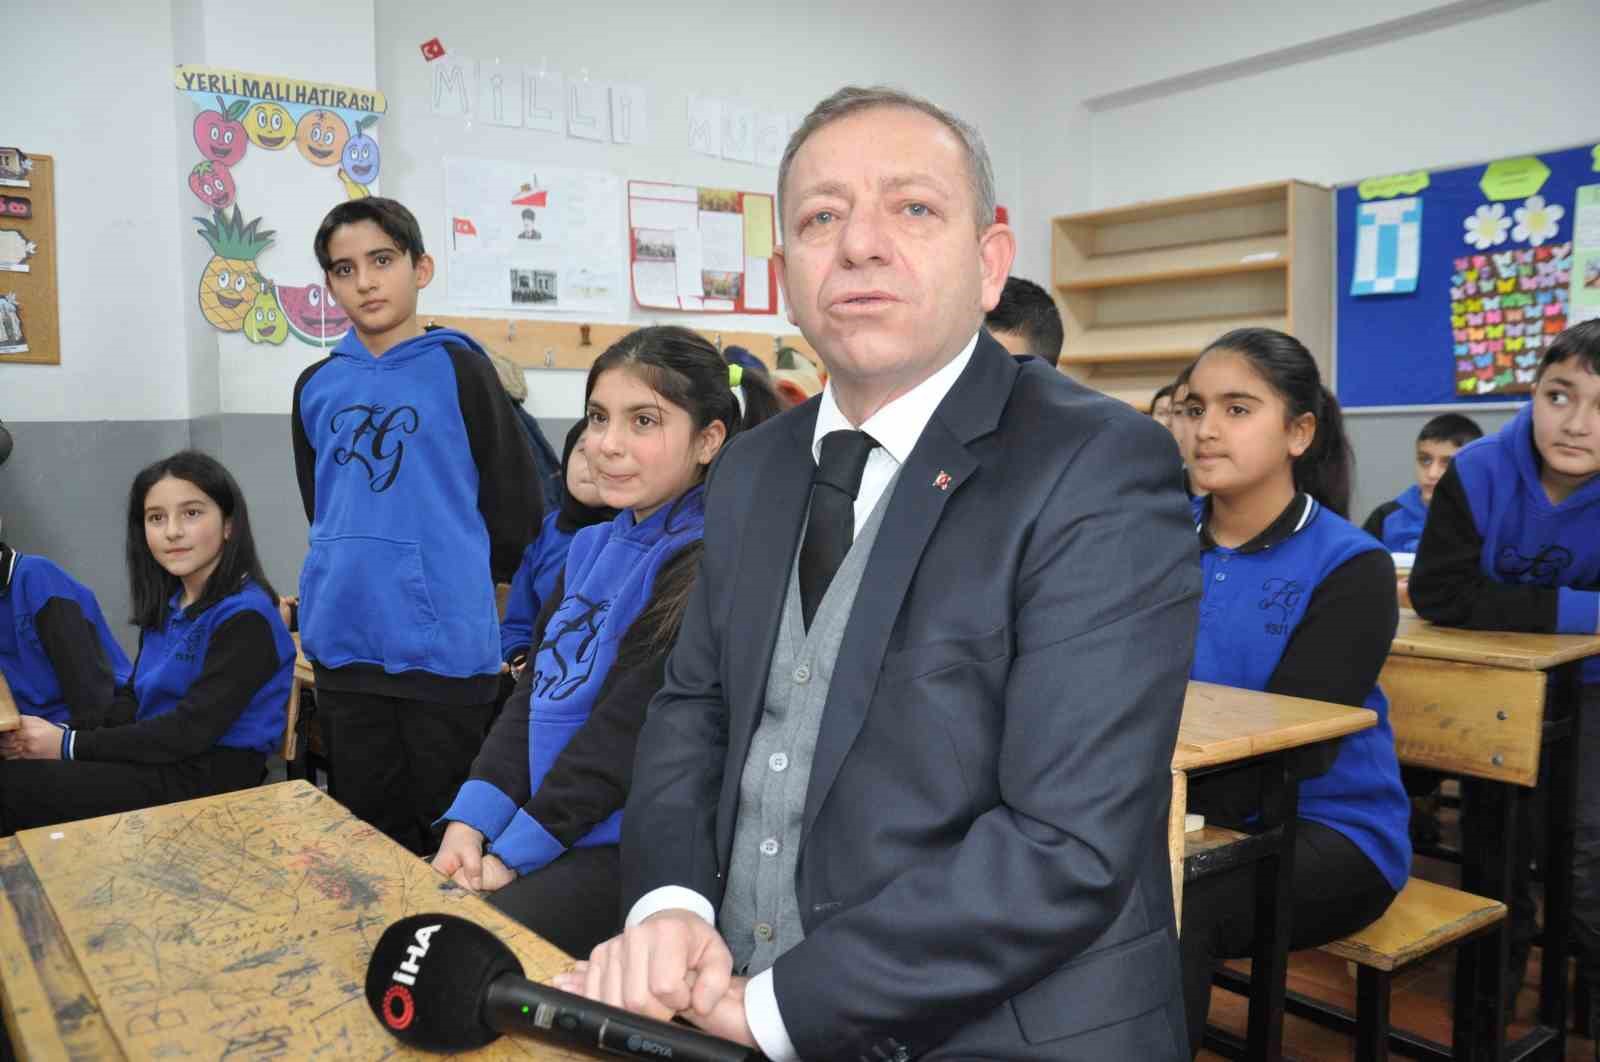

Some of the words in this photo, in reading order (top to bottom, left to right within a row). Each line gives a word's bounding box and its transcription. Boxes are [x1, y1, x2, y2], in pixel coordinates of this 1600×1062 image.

[181, 71, 237, 95] YERLİ
[242, 79, 291, 102] MALI
[295, 86, 376, 113] HATIRASI
